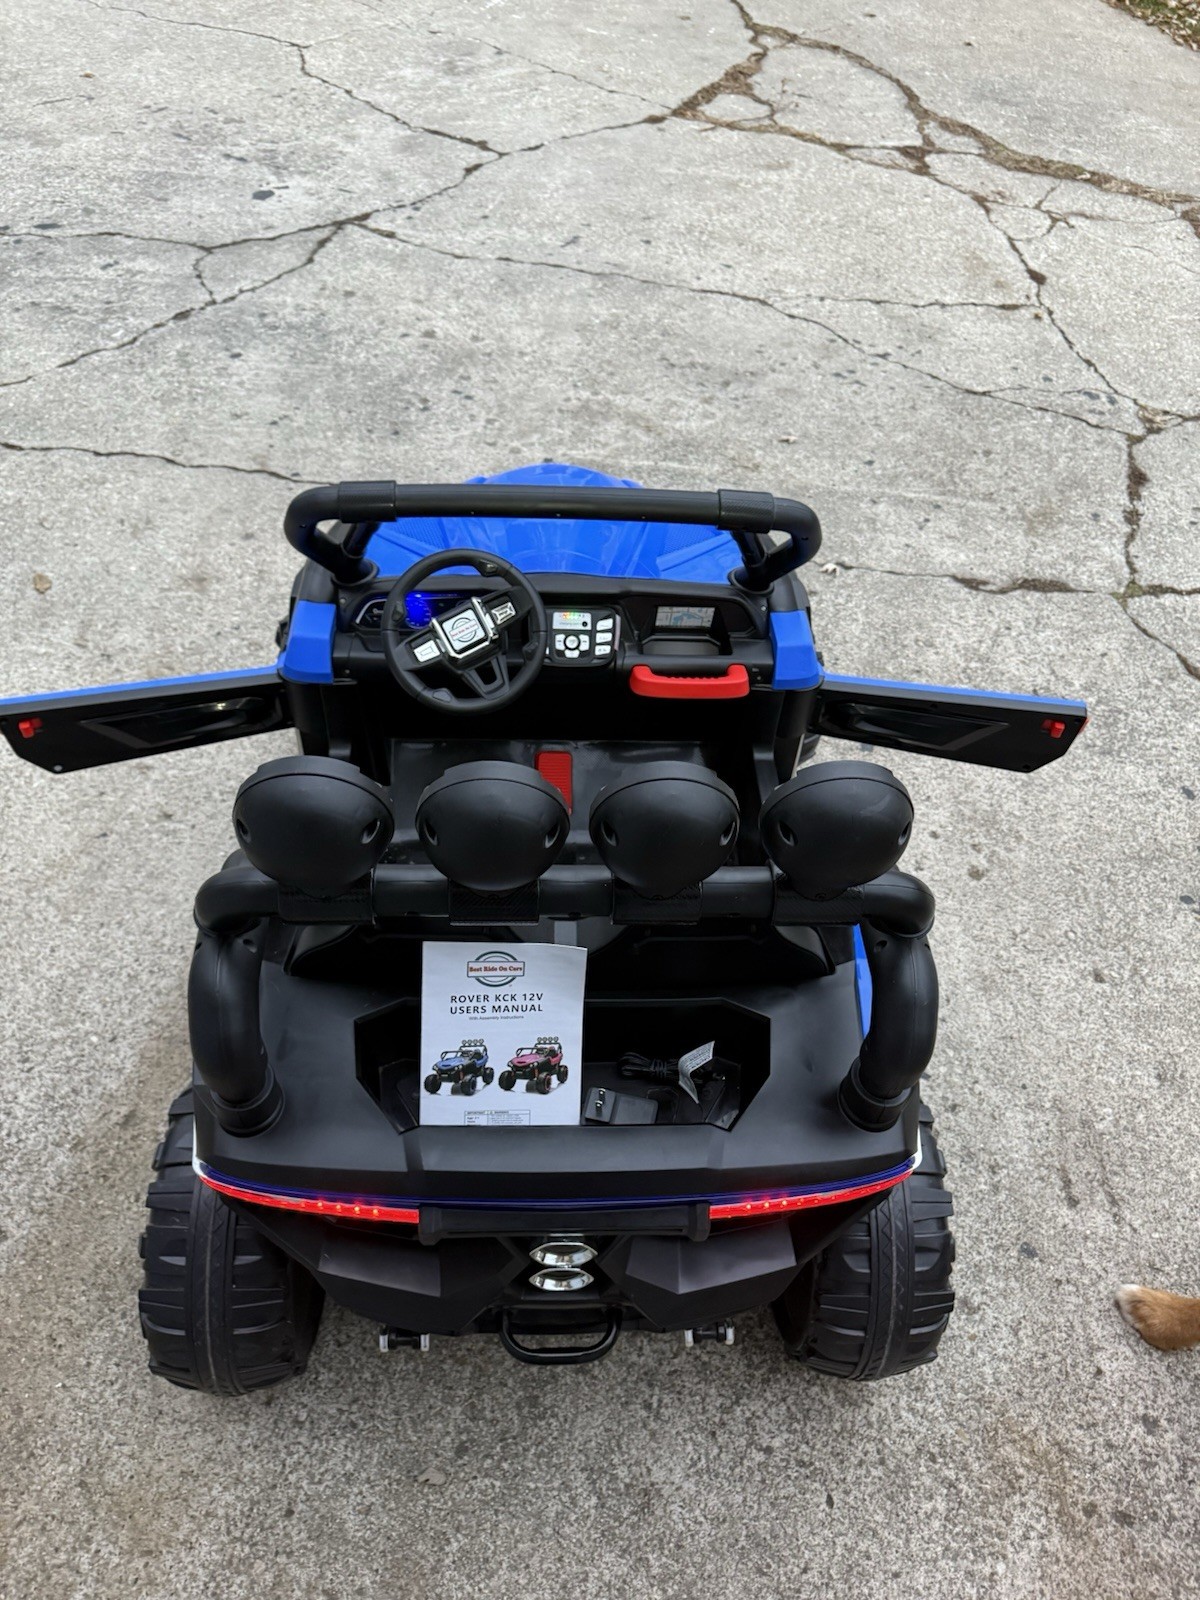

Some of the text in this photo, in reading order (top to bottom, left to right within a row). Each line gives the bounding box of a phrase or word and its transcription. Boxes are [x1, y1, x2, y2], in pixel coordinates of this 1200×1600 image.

[450, 993, 544, 1003] ROVER KCK 12V
[450, 1004, 543, 1014] USERS MANUAL
